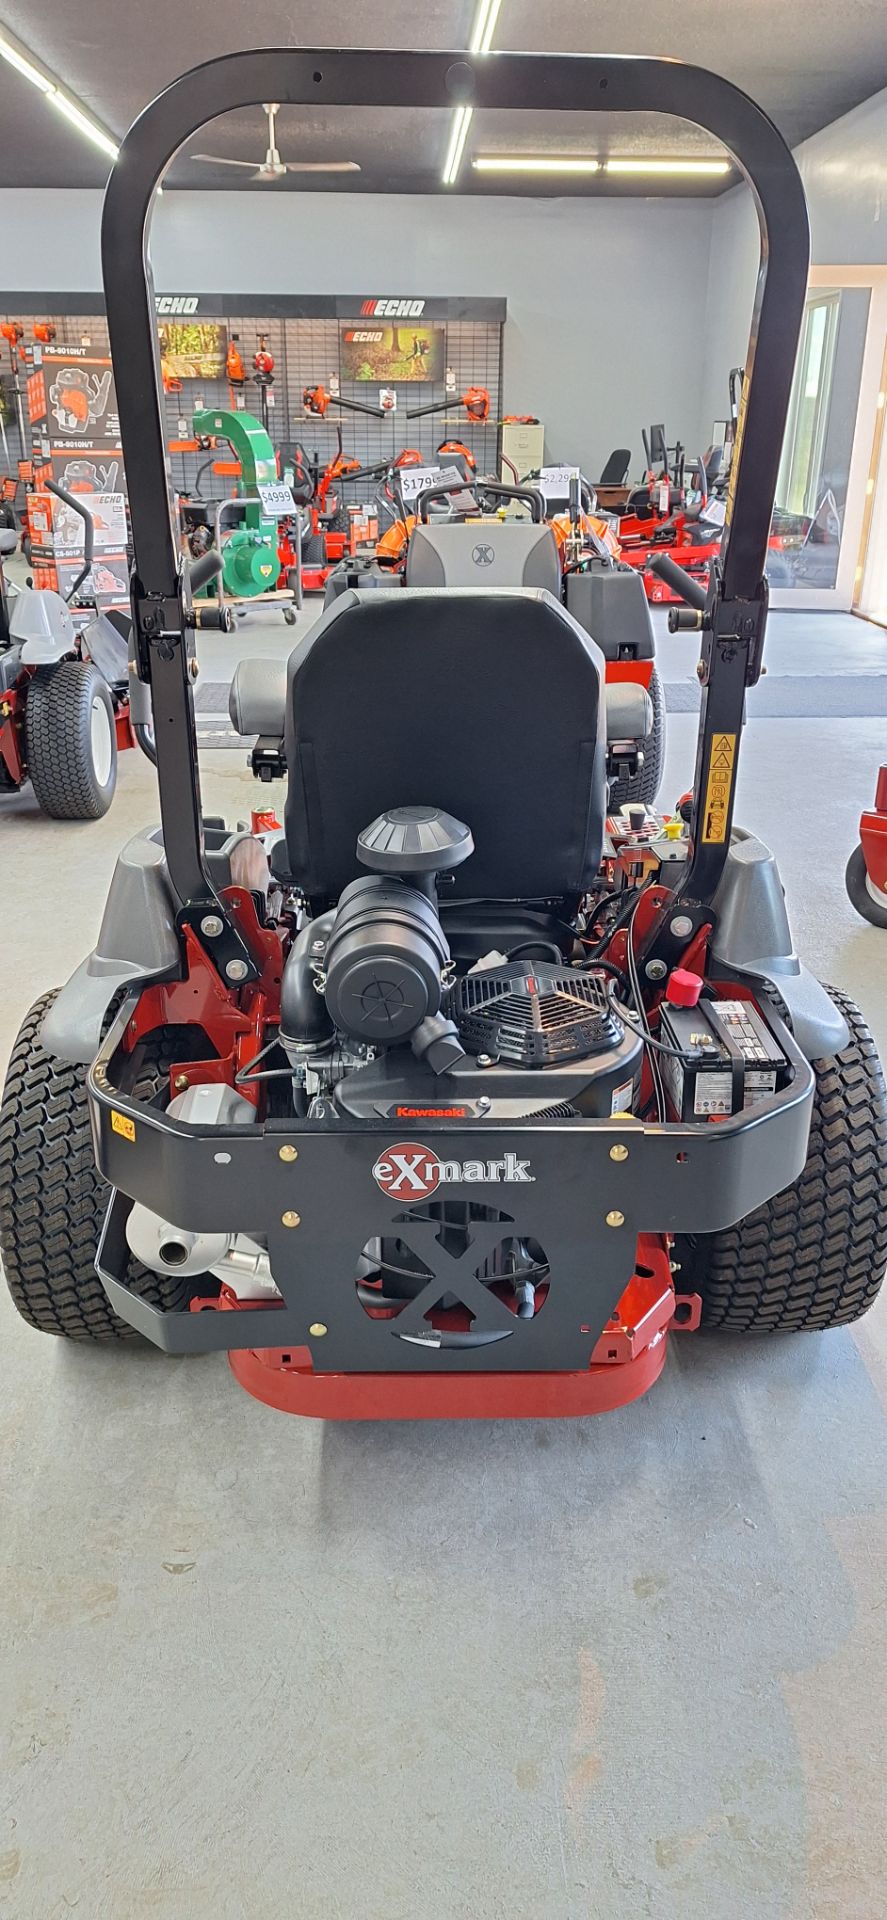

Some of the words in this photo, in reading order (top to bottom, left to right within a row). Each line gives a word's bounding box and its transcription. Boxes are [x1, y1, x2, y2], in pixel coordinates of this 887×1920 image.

[373, 300, 426, 317] ECHO
[352, 332, 384, 343] ECHO
[98, 495, 122, 504] ECHO
[262, 490, 291, 503] $4999
[396, 1107, 466, 1118] Kawasaki
[372, 1151, 535, 1191] eXmark
